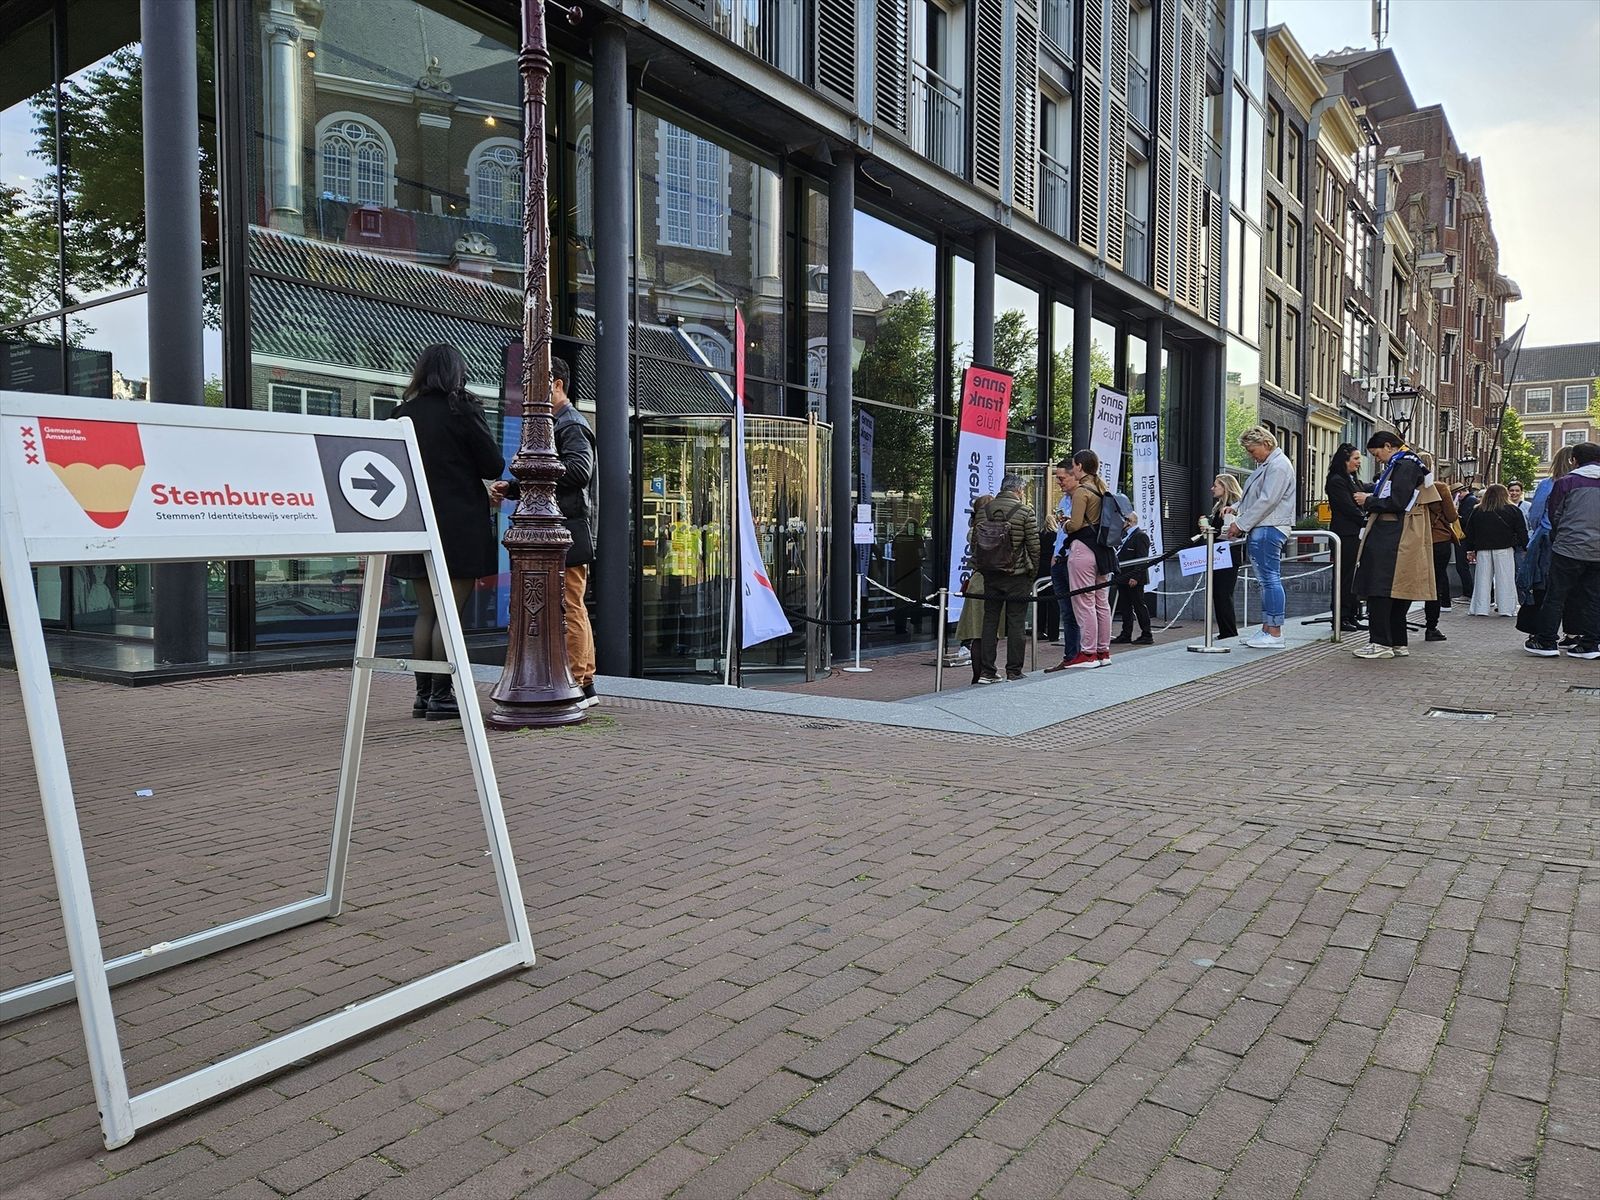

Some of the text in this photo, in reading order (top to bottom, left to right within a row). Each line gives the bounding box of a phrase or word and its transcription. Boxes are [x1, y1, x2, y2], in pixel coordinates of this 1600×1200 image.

[1133, 420, 1157, 430] anne
[43, 426, 81, 435] Gemeente
[45, 433, 87, 441] Amsterdam
[1133, 431, 1158, 444] frank
[150, 483, 315, 507] Stembureau
[156, 512, 318, 522] Stemmen? Identiteitsbewijs verplicht.
